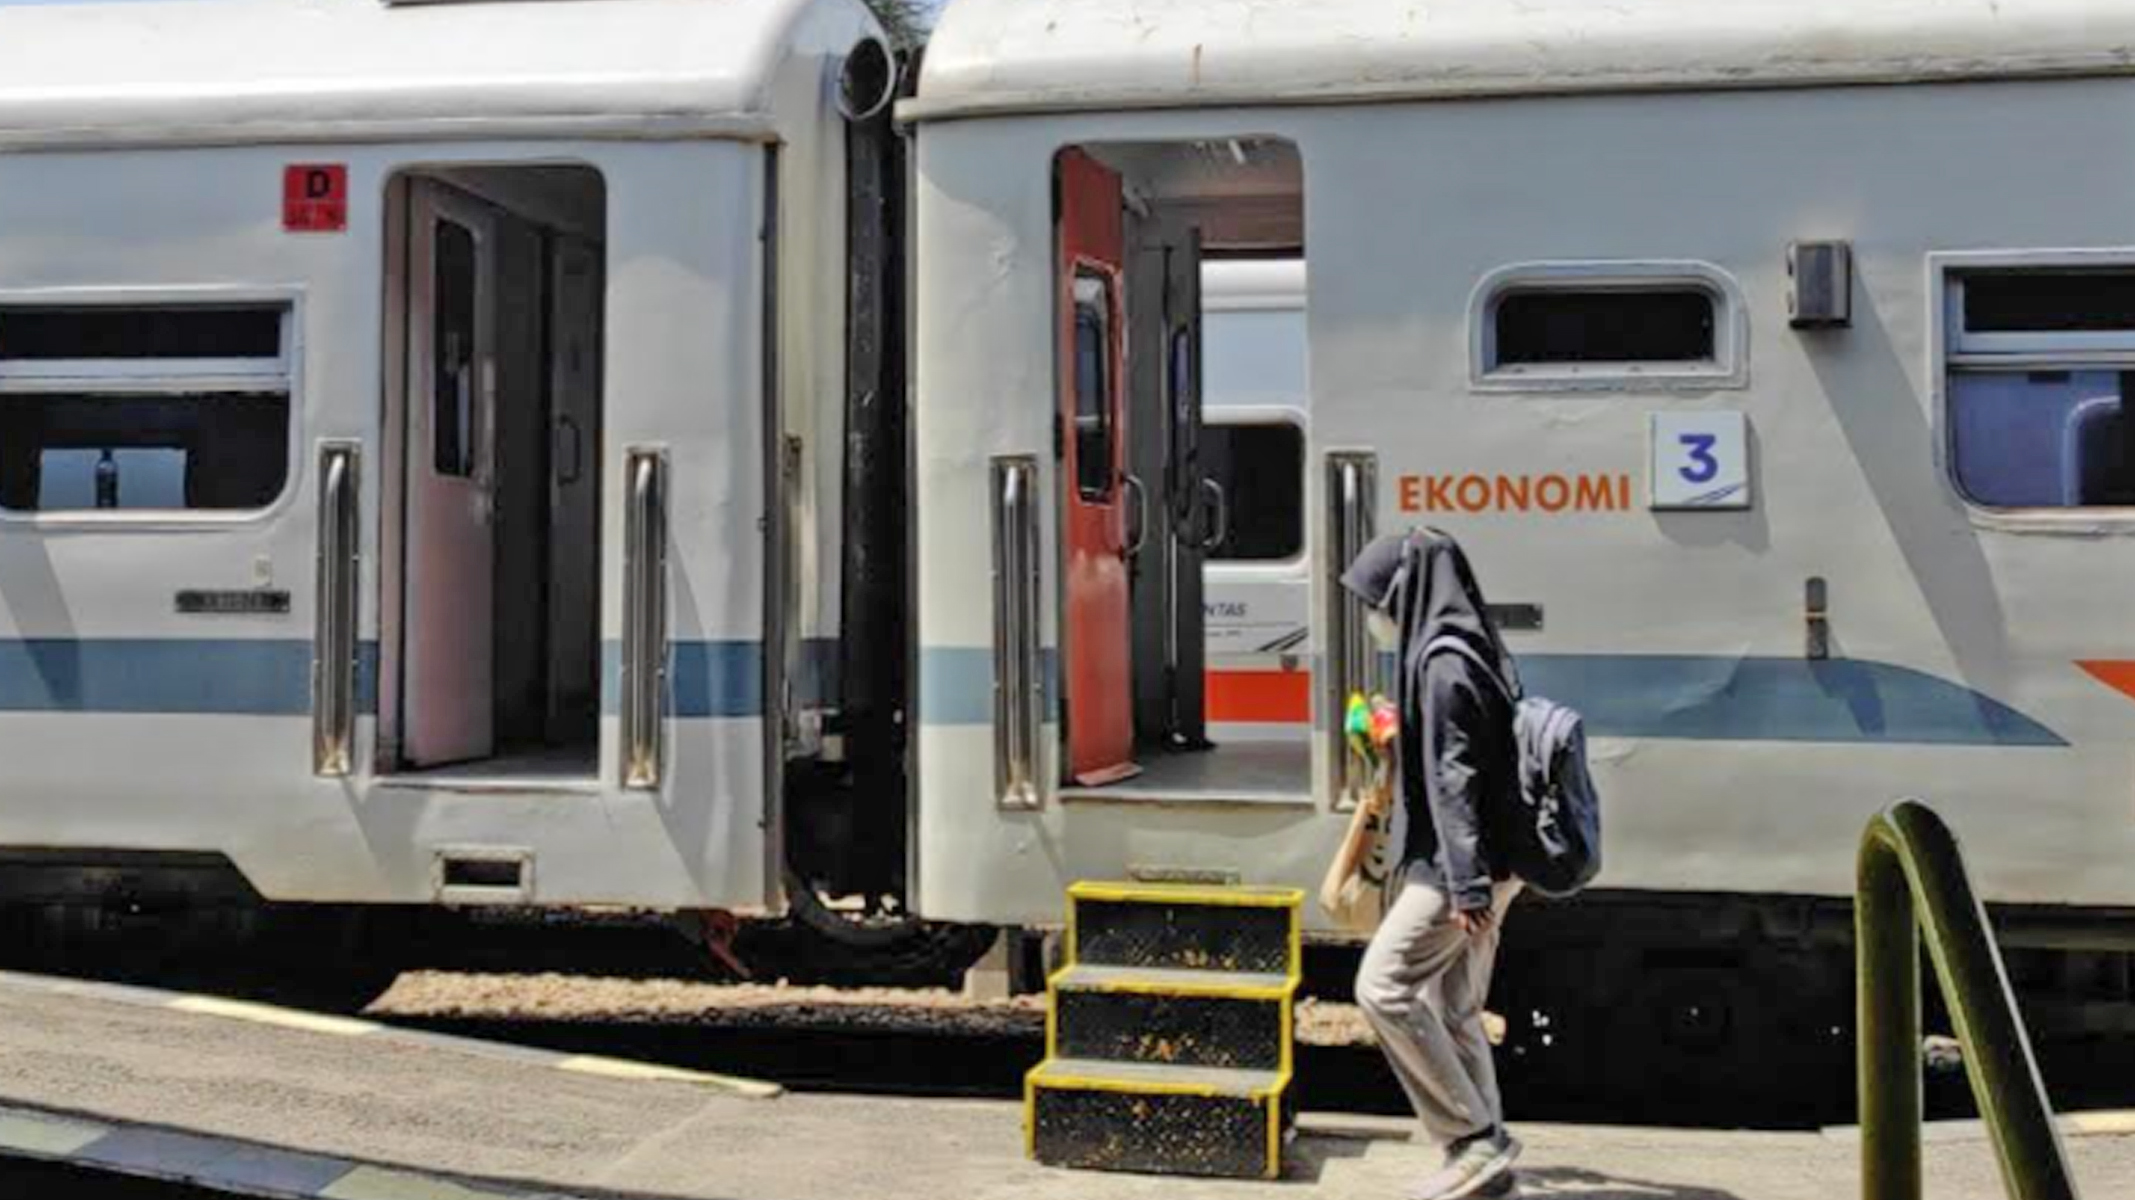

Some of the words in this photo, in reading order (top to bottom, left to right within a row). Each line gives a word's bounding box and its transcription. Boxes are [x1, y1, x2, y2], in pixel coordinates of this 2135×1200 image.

[306, 170, 331, 198] D
[1679, 433, 1718, 483] 3
[1400, 474, 1631, 512] EKONOMI
